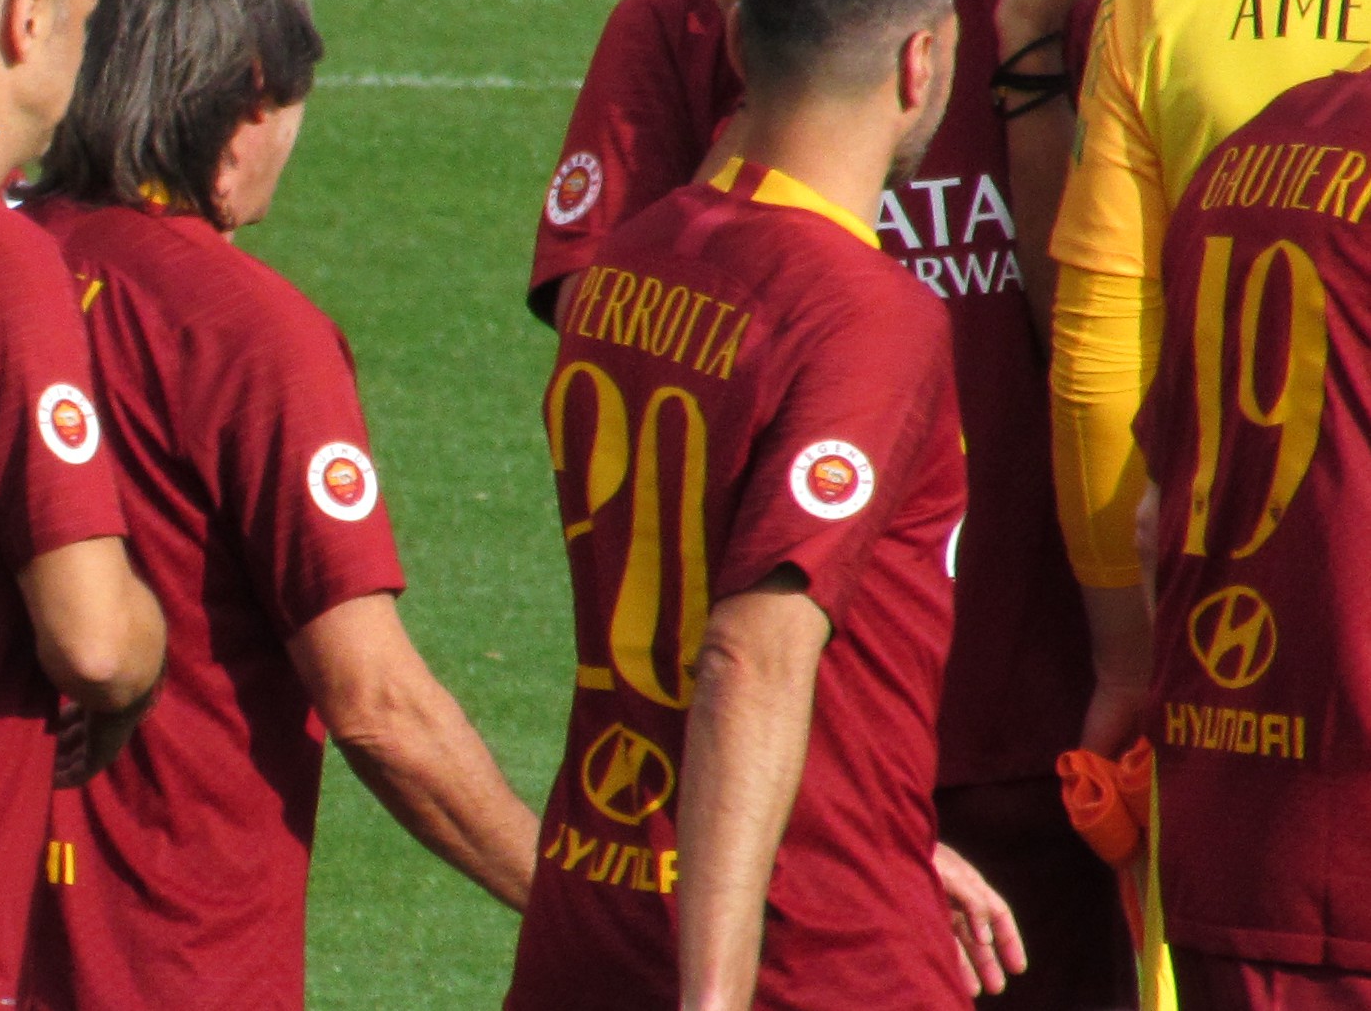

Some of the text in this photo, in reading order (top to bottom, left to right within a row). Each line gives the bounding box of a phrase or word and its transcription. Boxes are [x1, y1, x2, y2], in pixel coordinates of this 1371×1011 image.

[566, 265, 751, 380] PERROTTA
[898, 250, 1025, 299] RWA
[1183, 236, 1328, 559] 19
[543, 361, 709, 710] 20
[1164, 700, 1306, 761] HYUNDAI
